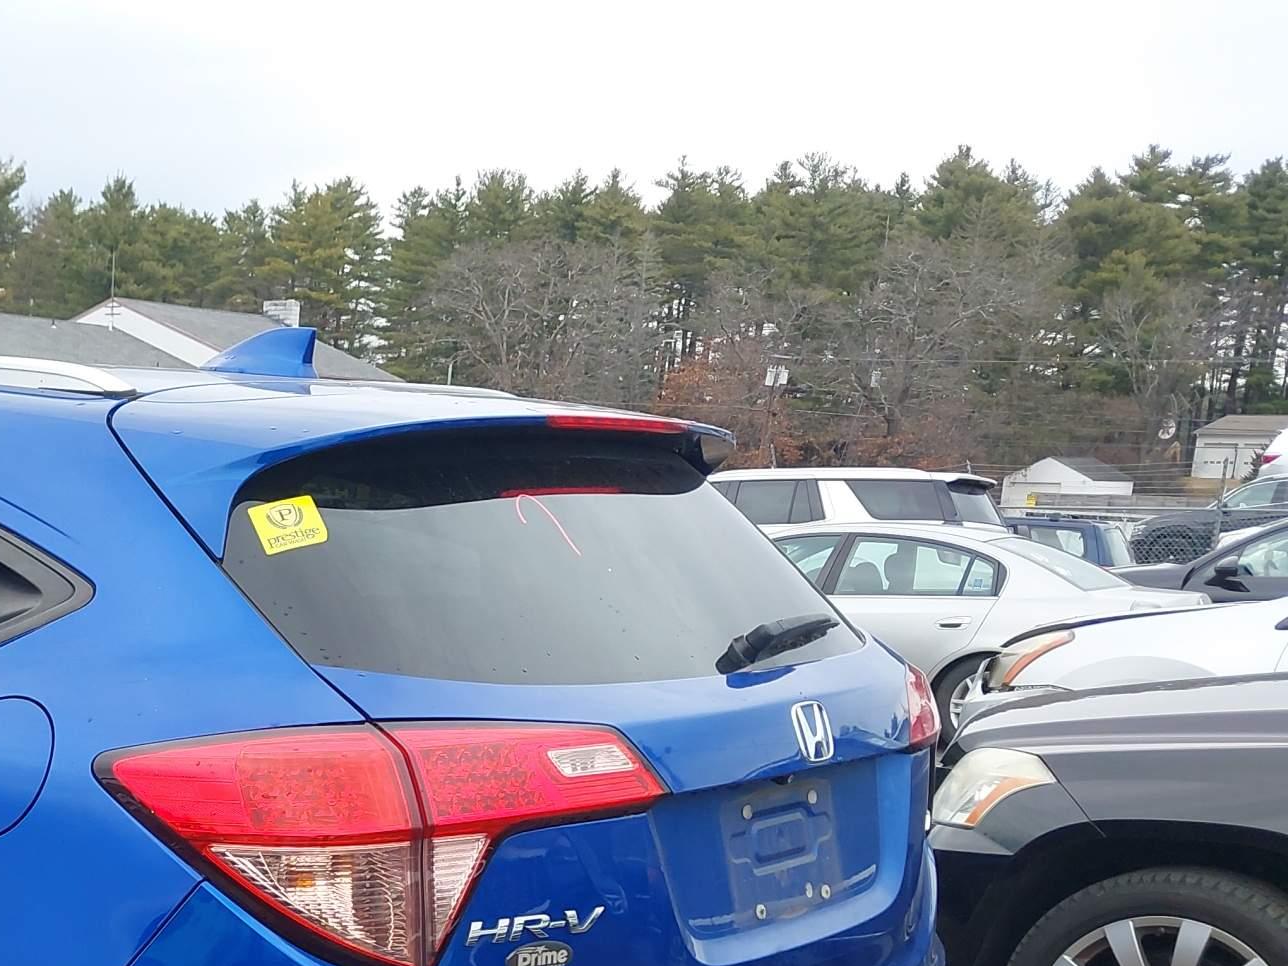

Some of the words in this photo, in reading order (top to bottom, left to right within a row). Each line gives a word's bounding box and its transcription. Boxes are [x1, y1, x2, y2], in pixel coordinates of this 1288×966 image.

[275, 508, 292, 522] P
[267, 527, 321, 549] prestige
[466, 906, 605, 946] HR-V
